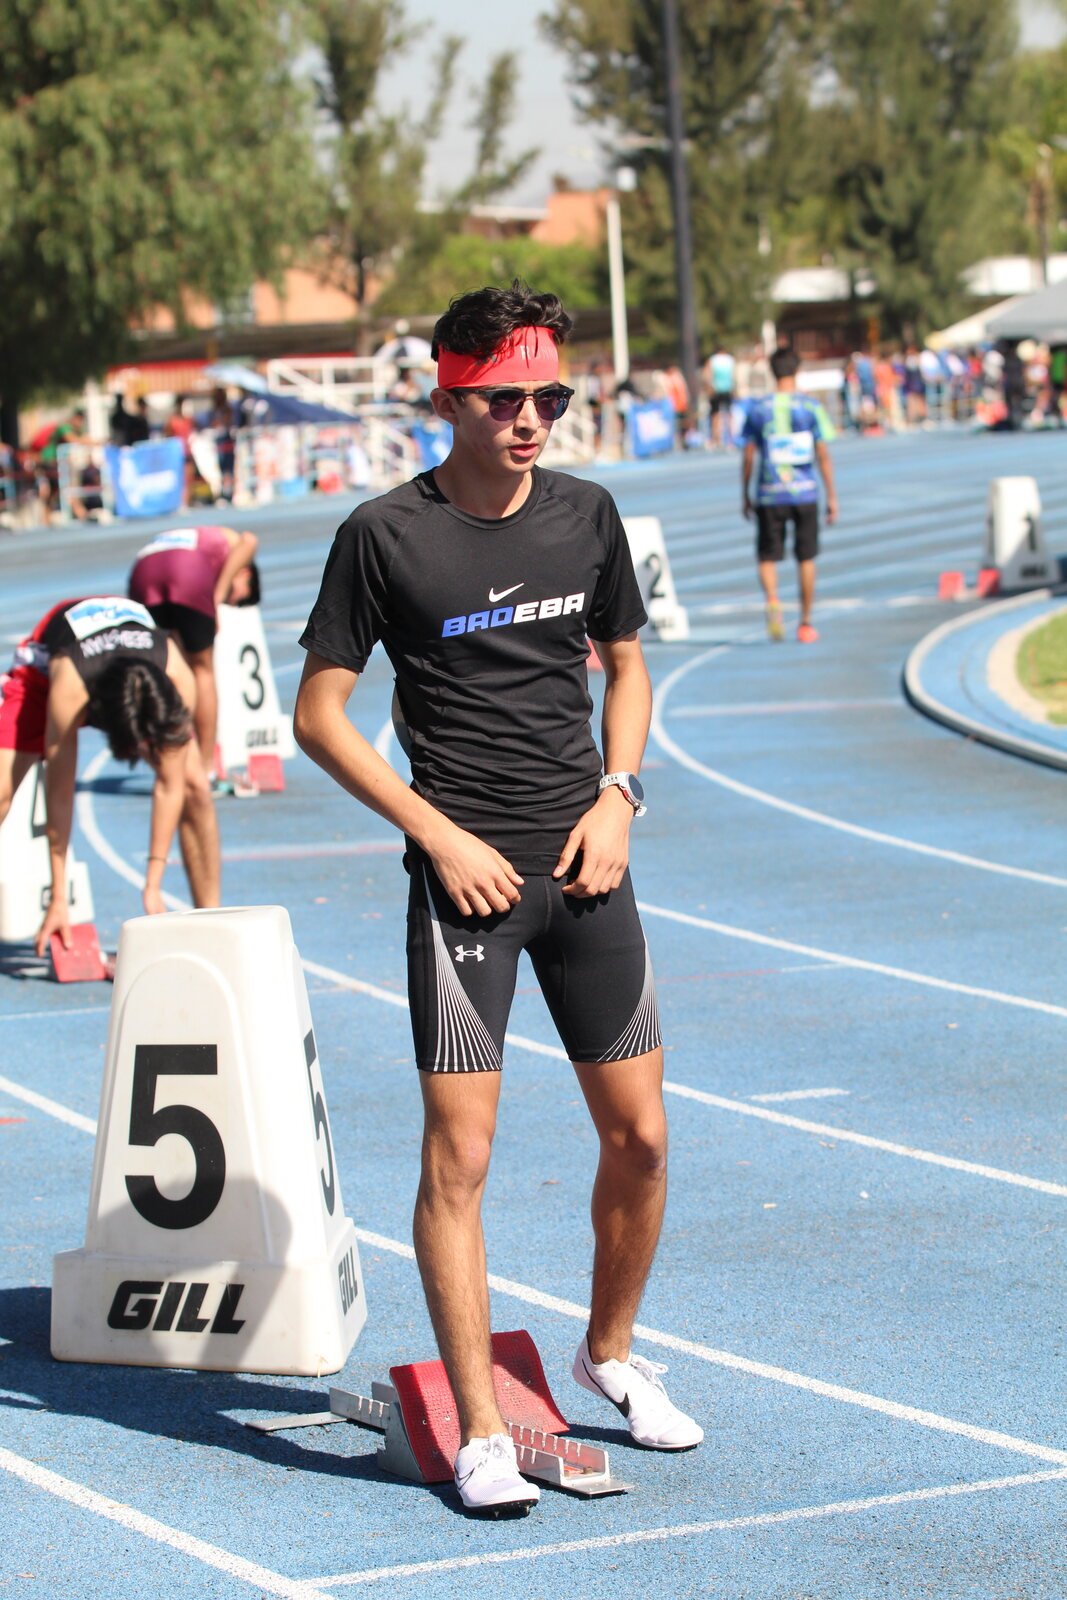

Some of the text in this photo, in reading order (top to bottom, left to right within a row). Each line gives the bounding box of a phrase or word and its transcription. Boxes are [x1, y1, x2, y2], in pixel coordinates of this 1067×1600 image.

[644, 553, 666, 599] 2
[441, 592, 586, 638] BADEBA
[240, 644, 264, 711] 3
[125, 1044, 226, 1230] 5
[303, 1028, 335, 1217] 5
[107, 1280, 246, 1334] GILL
[338, 1246, 358, 1317] GILL
